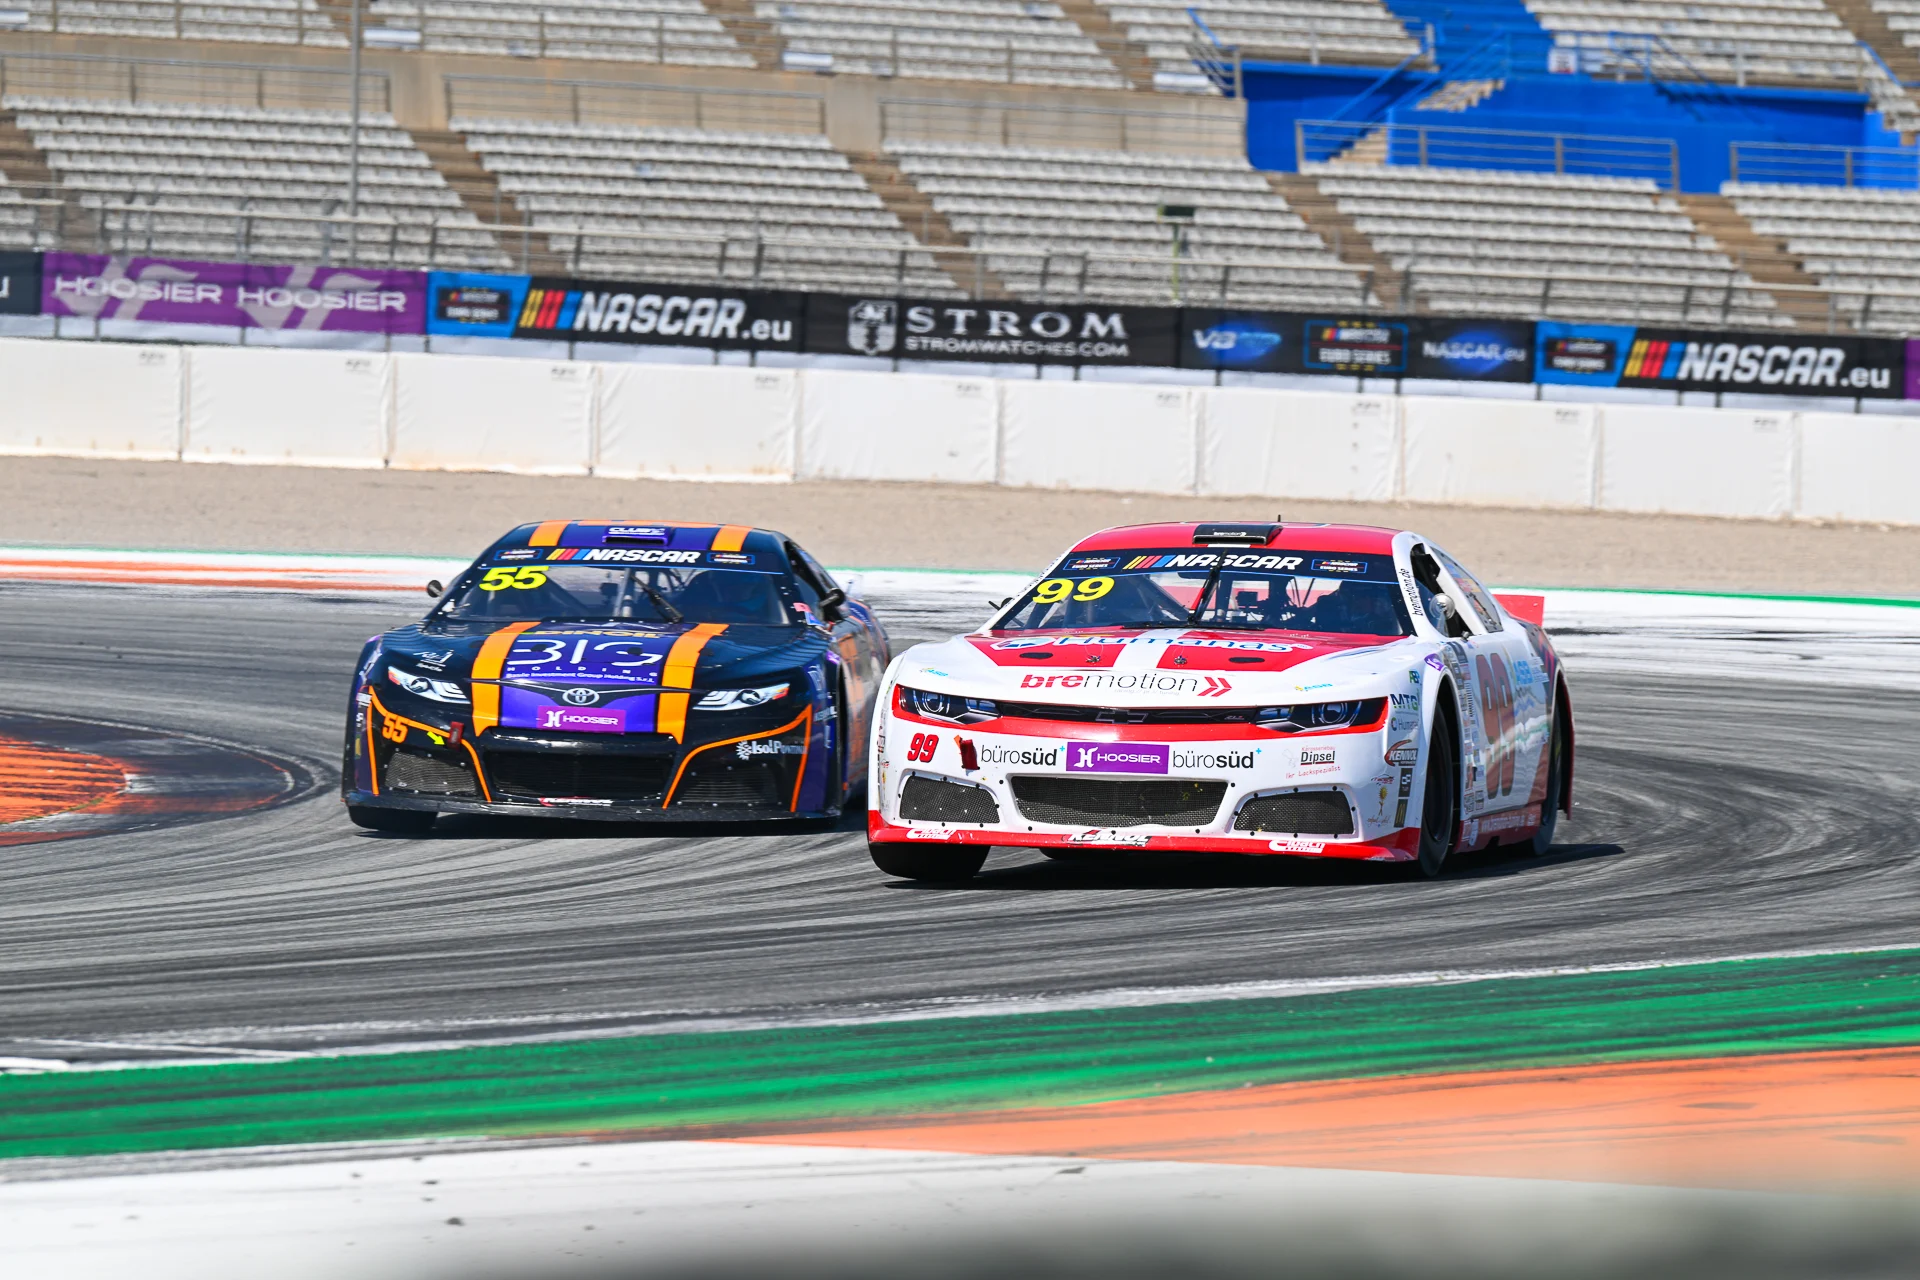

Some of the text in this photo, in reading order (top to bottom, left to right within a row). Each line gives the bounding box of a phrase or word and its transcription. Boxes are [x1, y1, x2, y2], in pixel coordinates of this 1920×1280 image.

[54, 275, 223, 304] HOOSIER
[237, 285, 407, 313] HOOSIER
[573, 291, 793, 341] NASCAR.eu
[906, 306, 1129, 340] STROM
[905, 336, 1130, 358] STROMWATCHES.COM
[1422, 341, 1527, 362] NASCAR.eu
[1675, 341, 1891, 389] NASCAR.eu
[584, 548, 701, 563] NASCAR
[1165, 553, 1304, 570] NASCAR
[479, 566, 549, 591] 55
[1033, 577, 1114, 604] 99
[1020, 673, 1198, 692] bremotion
[382, 713, 408, 744] 55
[563, 715, 619, 725] HOOSIER
[907, 732, 939, 763] 99
[981, 745, 1057, 767] bürosüd
[1097, 753, 1160, 764] HOOSIER
[1301, 751, 1335, 764] Dipsel
[1389, 750, 1417, 760] KENNOL
[1173, 750, 1253, 769] bürosüd
